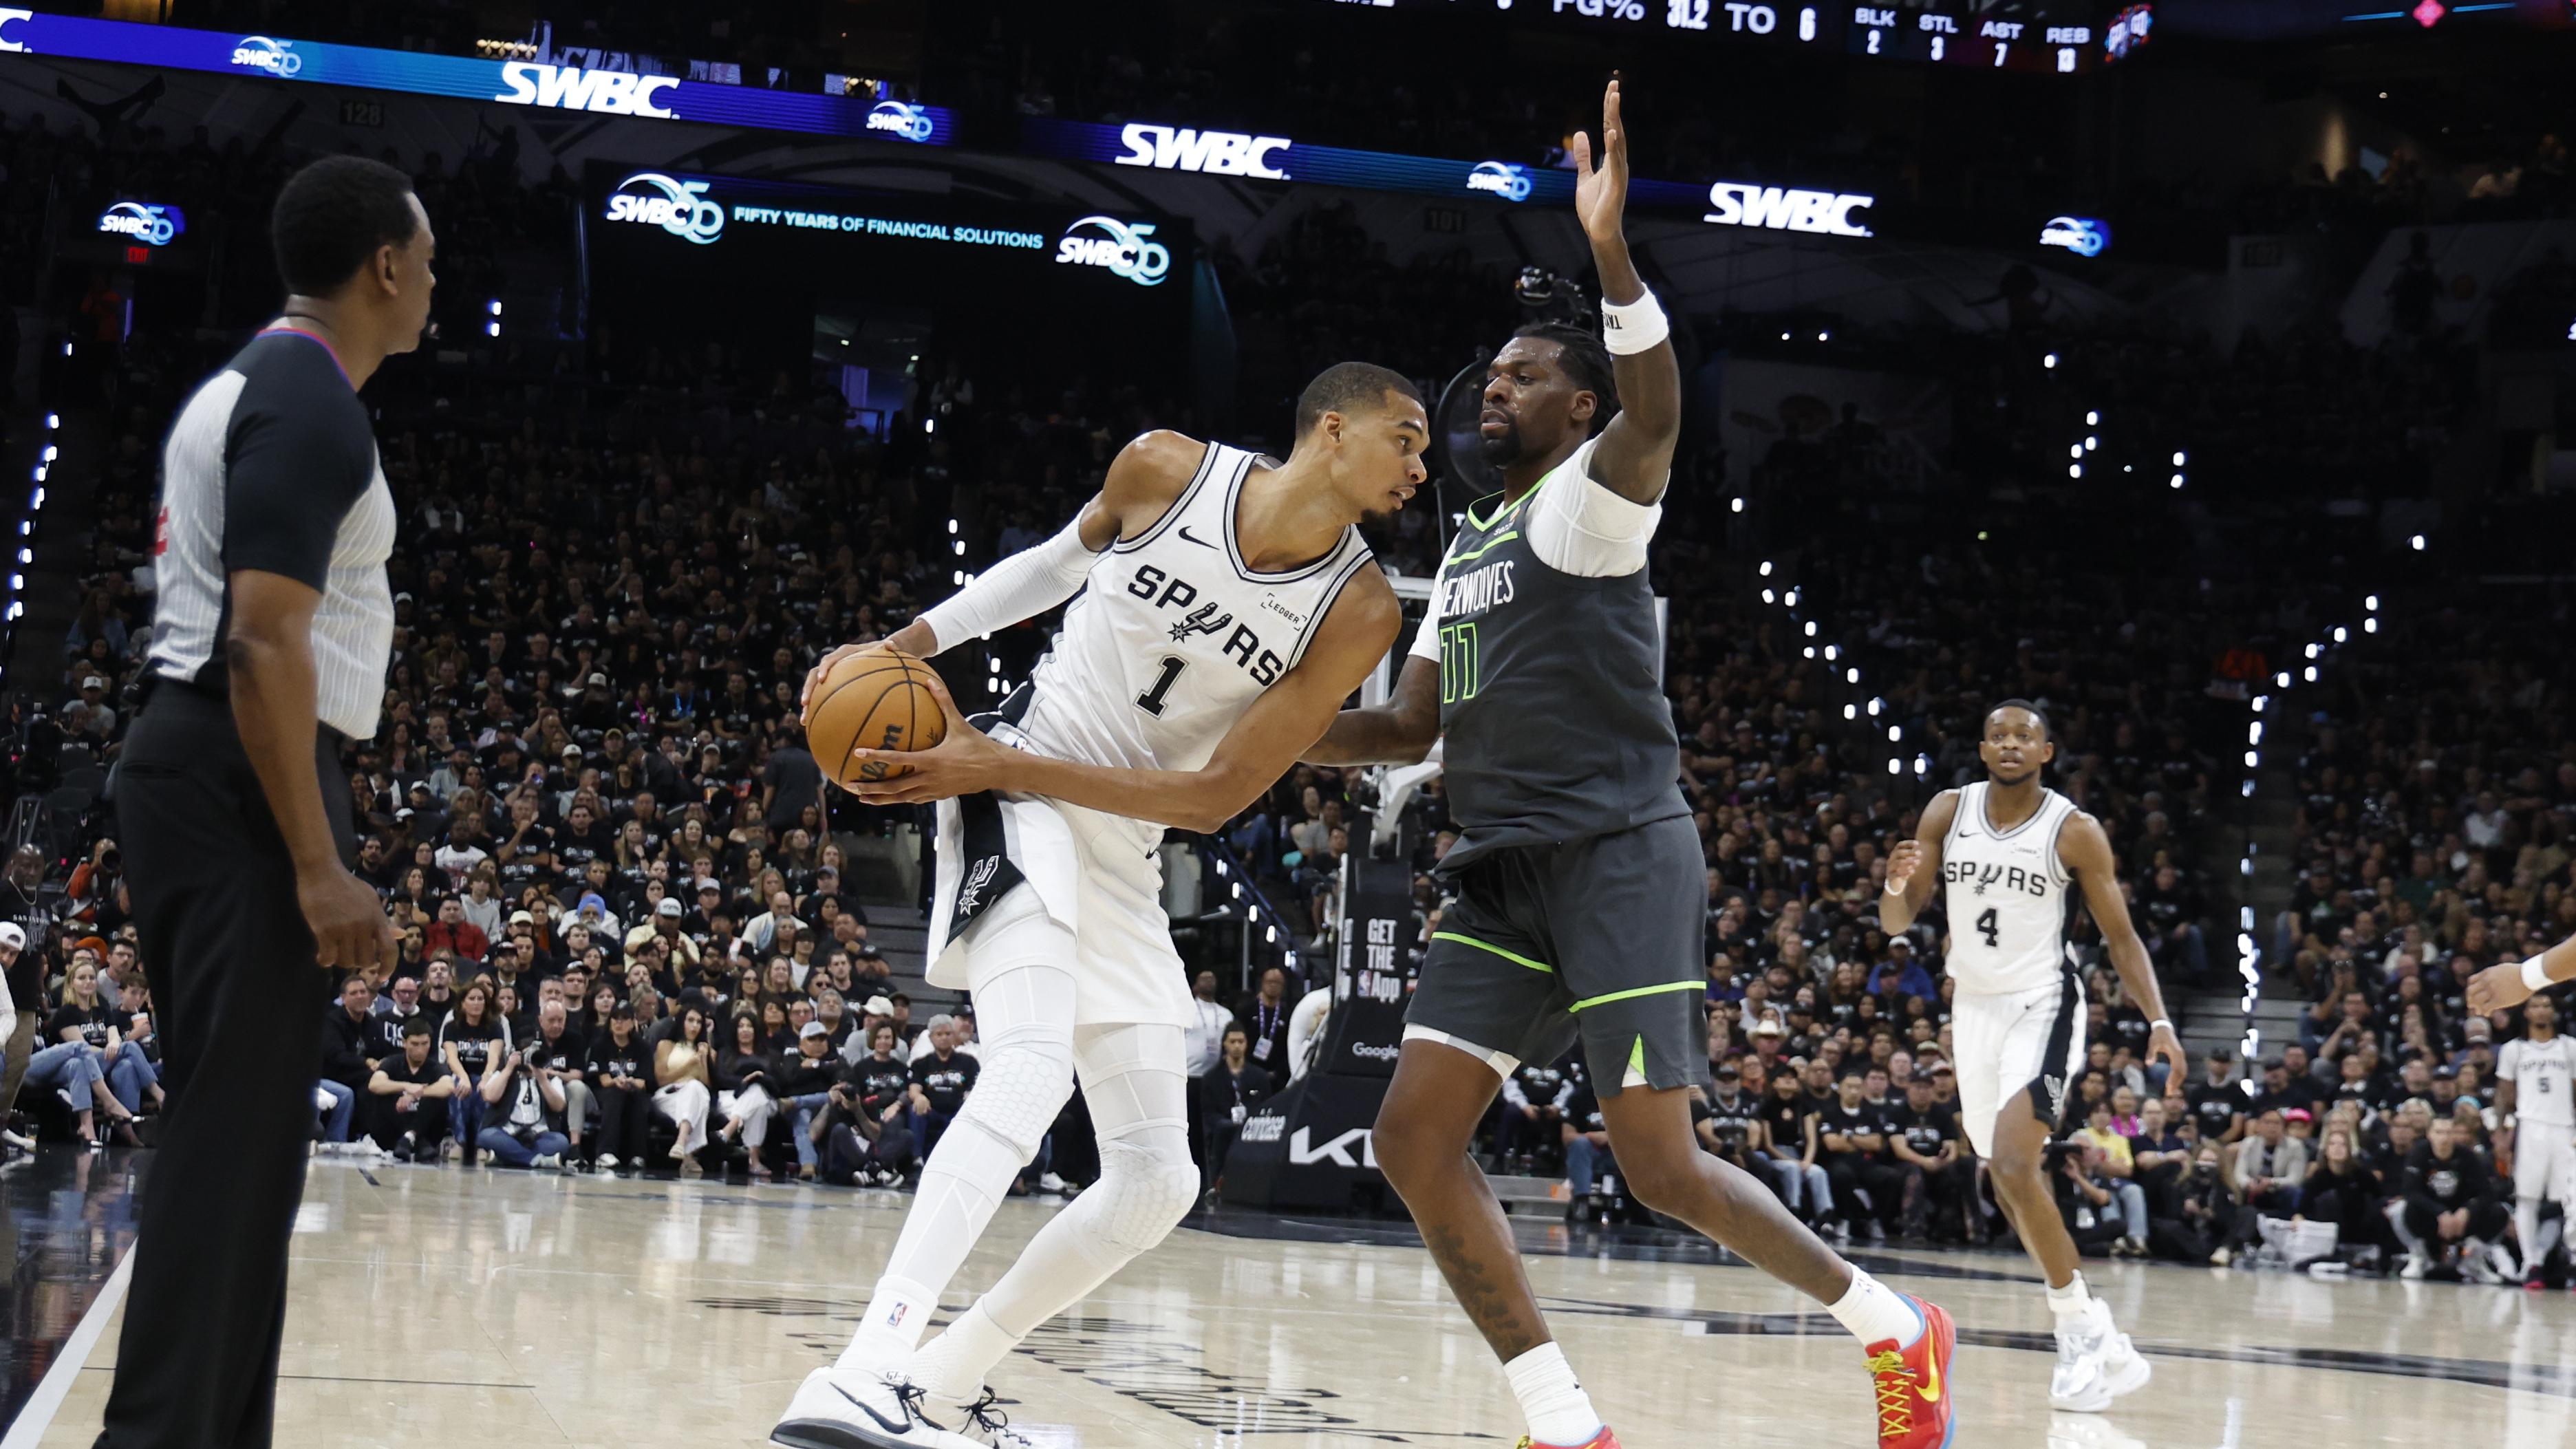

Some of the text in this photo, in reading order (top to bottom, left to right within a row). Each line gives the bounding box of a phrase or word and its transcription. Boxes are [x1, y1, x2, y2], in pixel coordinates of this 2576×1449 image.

[1724, 3, 1775, 34] TO
[1799, 8, 1816, 41] 6
[1855, 8, 1895, 27] BLK
[1919, 14, 1958, 33] STL
[1980, 21, 2024, 39] AST
[1867, 30, 1880, 54] 2
[2046, 28, 2090, 43] REB
[232, 48, 281, 67] SWBC
[1995, 43, 2008, 67] 7
[495, 61, 680, 119] SWBC
[343, 103, 383, 125] 128
[866, 113, 914, 132] SWBC
[1115, 123, 1291, 180] SWBC
[101, 215, 153, 235] SWBC
[606, 195, 691, 226] SWBC
[1704, 182, 1873, 237] SWBC
[733, 206, 1044, 249] FIFTY YEARS OF FINANCIAL SOLUTIONS
[1055, 237, 1137, 268] SWBC
[1440, 560, 1514, 618] ERWOLVES
[1128, 564, 1284, 687] SPURS
[1267, 599, 1300, 625] LEDGER
[1439, 622, 1478, 705] 11
[1135, 655, 1188, 718] 1
[1946, 861, 2047, 897] SPURS
[1367, 918, 1397, 945] GET
[1976, 908, 1999, 948] 4
[1366, 944, 1397, 971] THE
[1371, 971, 1401, 1004] App
[1352, 1041, 1399, 1062] Google
[1289, 1124, 1379, 1169] KI
